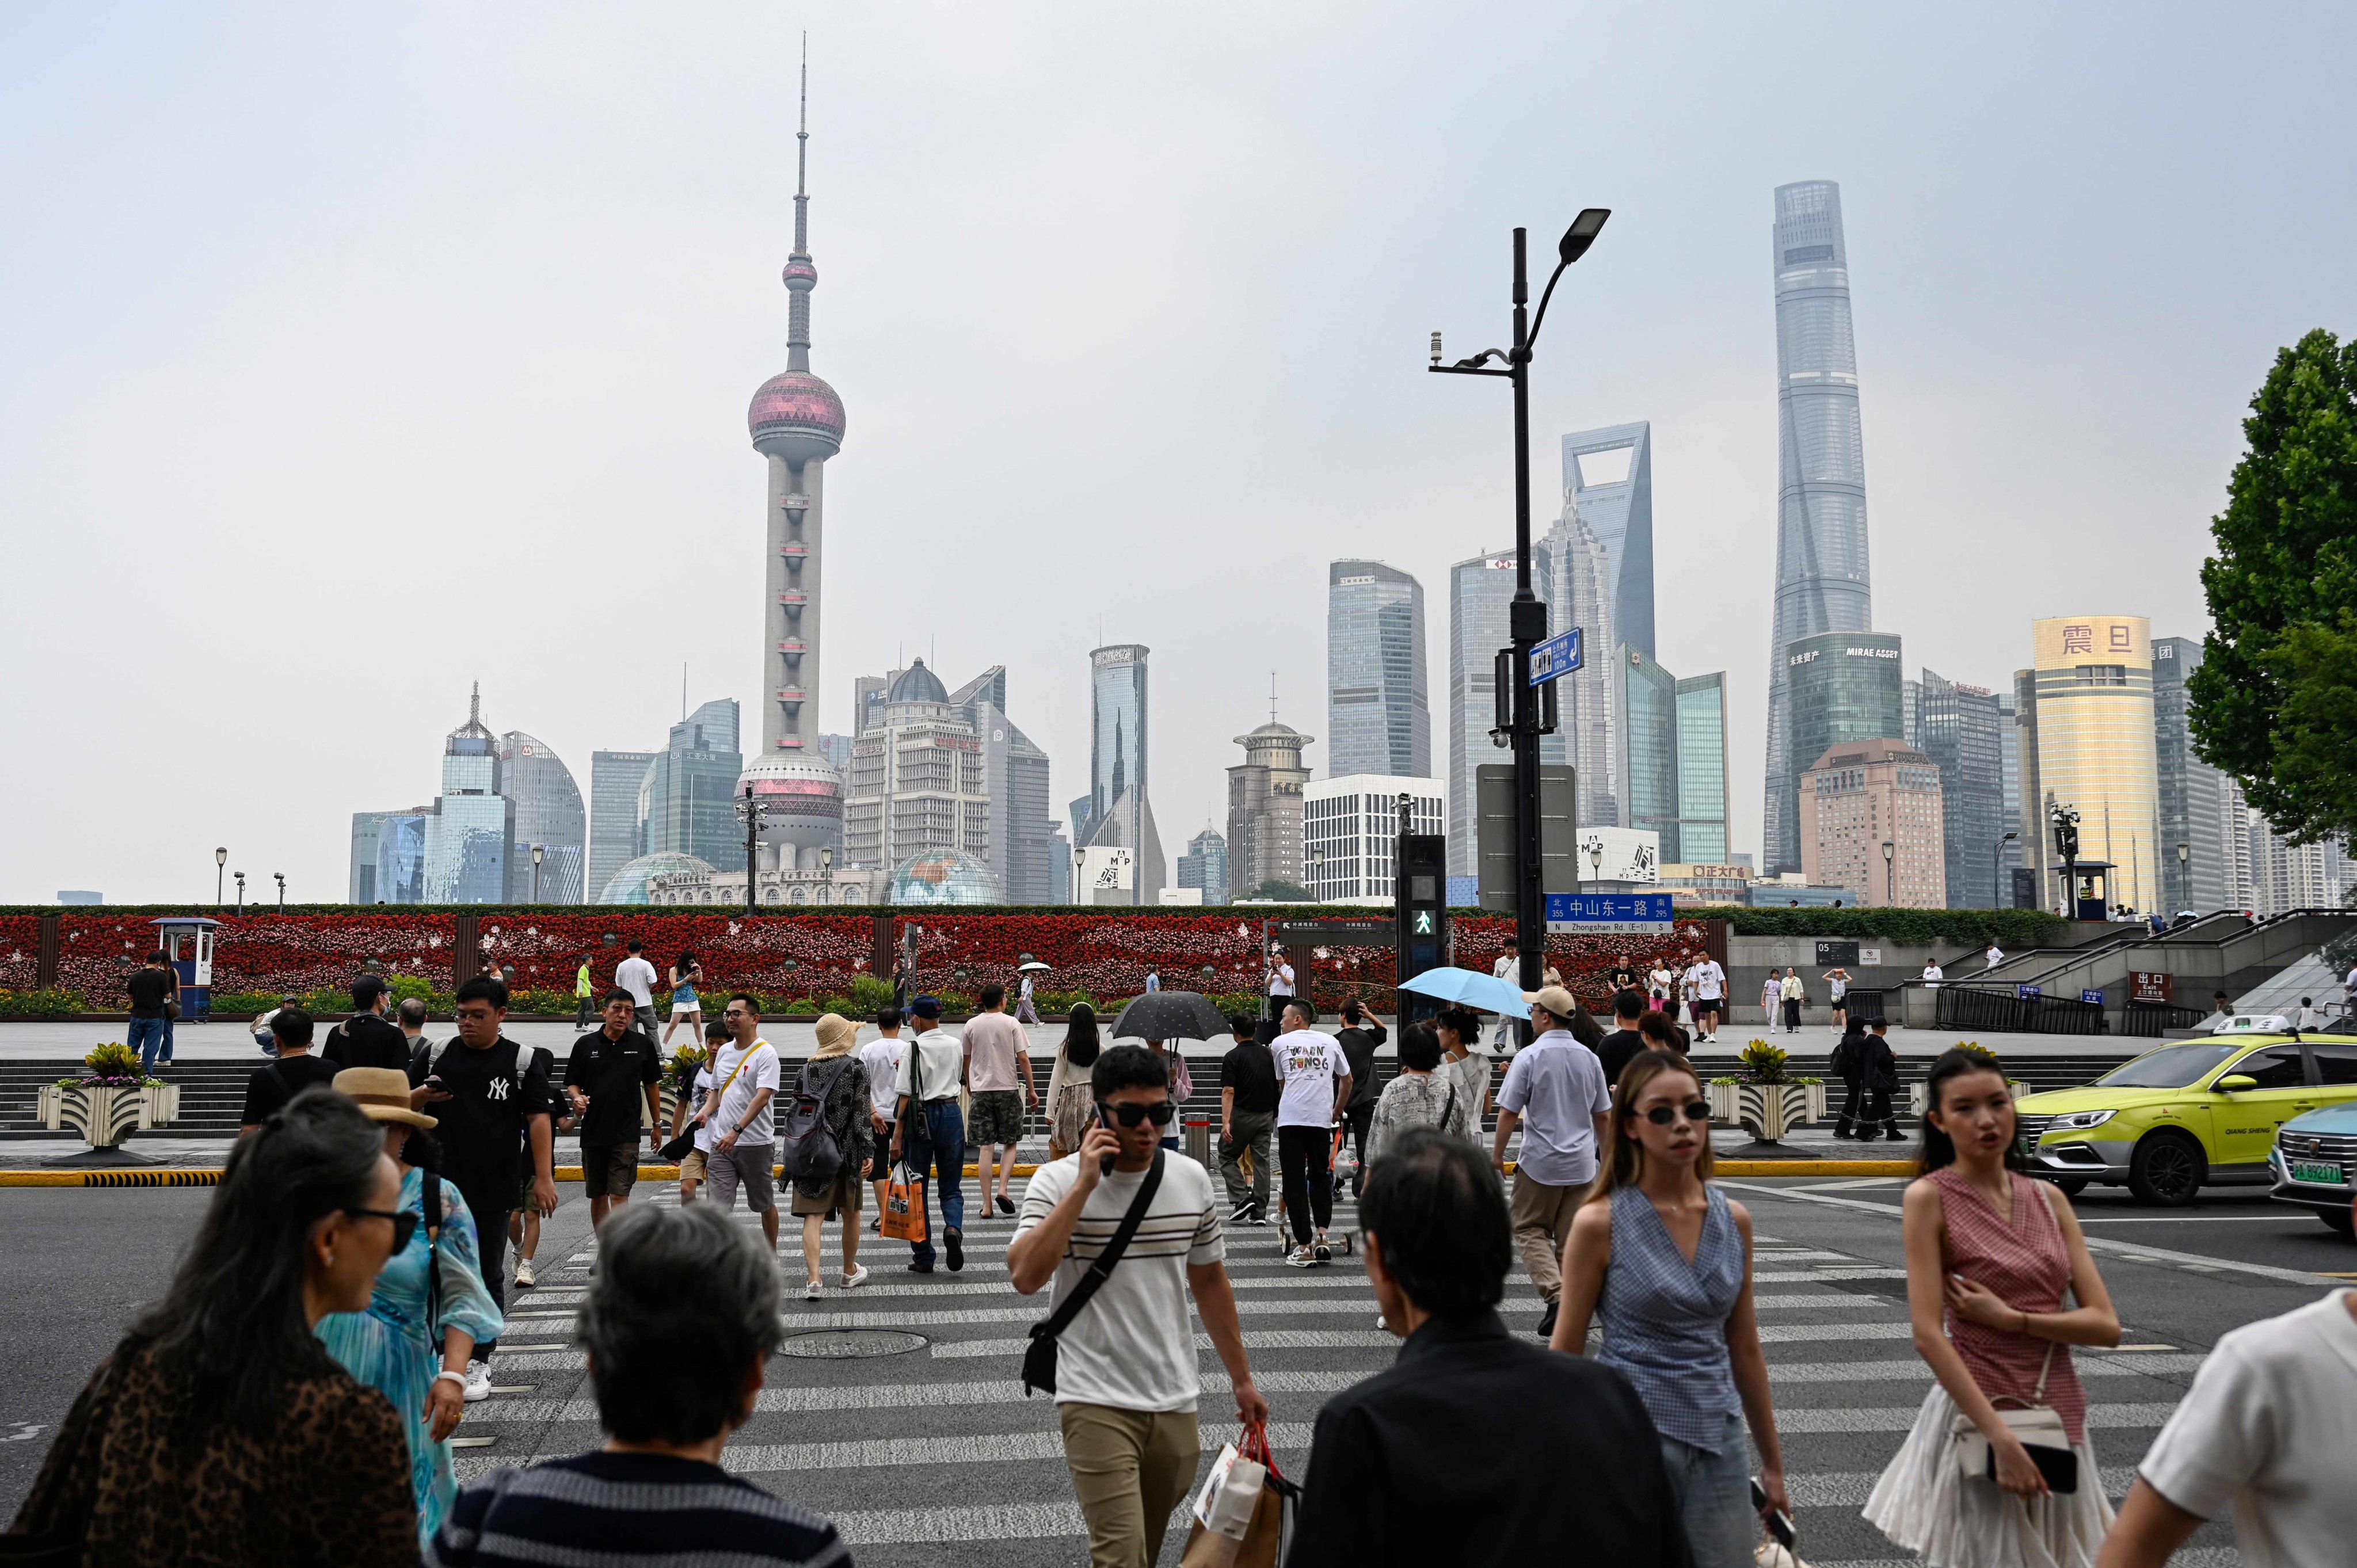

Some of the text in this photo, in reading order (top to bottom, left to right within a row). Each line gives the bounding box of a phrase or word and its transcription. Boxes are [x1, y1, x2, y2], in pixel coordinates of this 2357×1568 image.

[2063, 625, 2132, 654] 震旦
[1790, 650, 1820, 666] 未来资产
[1846, 647, 1898, 658] MIRAE ASSET
[1555, 659, 1566, 670] 100m
[687, 752, 716, 761] 汇亚大厦
[1895, 754, 1929, 764] SHANGRI-LA
[1707, 866, 1744, 878] 正大广场
[1570, 899, 1647, 917] 中山东一路
[1657, 898, 1665, 907] 南
[1572, 923, 1610, 932] Zhongshan
[1629, 923, 1647, 932] (E-1)
[1819, 944, 1829, 952] 05
[2138, 972, 2162, 984] 出口
[487, 1077, 510, 1100] NY
